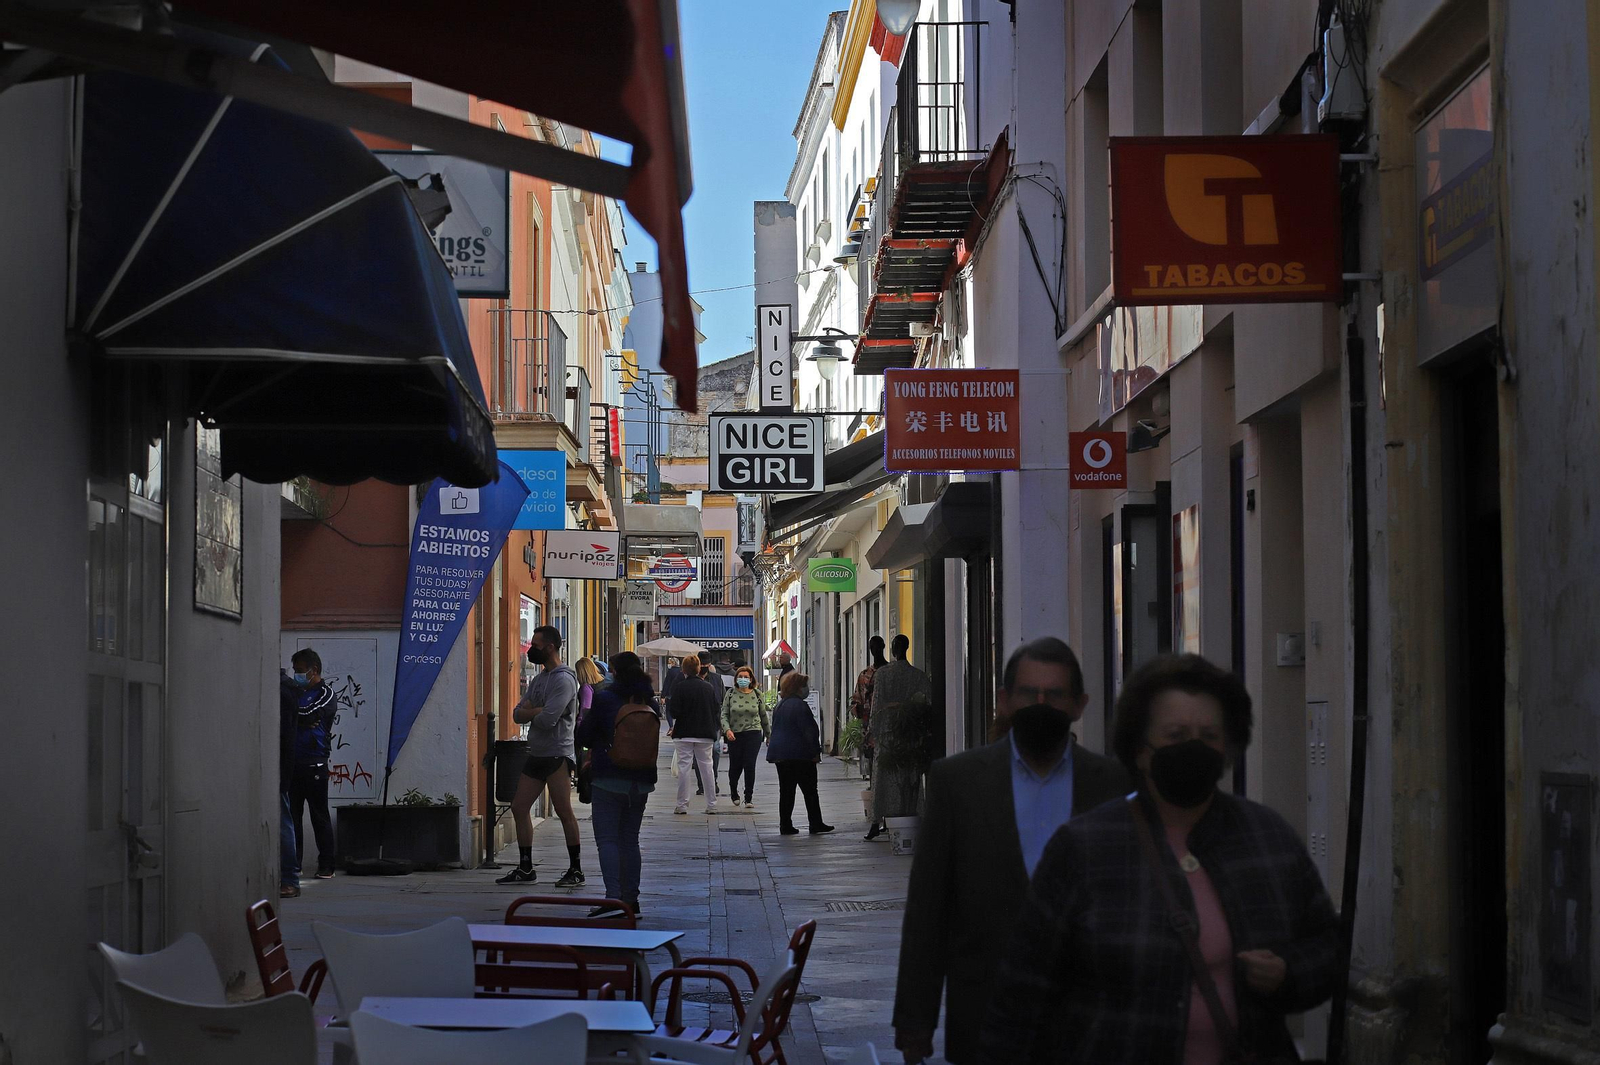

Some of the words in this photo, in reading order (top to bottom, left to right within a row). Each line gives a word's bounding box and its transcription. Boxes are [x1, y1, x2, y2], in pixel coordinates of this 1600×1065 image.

[1143, 261, 1307, 288] TABACOS
[768, 310, 784, 401] NICE
[893, 381, 926, 398] YONG
[929, 381, 959, 398] FENG
[962, 381, 1015, 398] TELECOM
[905, 410, 1008, 433] 荣丰电讯
[725, 423, 808, 449] NICE
[892, 448, 938, 460] ACCESORIOS
[939, 448, 982, 460] TELEFONOS
[983, 448, 1016, 460] MOVILES
[725, 457, 808, 484] GIRL
[1074, 471, 1122, 481] vodafone
[542, 488, 557, 499] de
[419, 524, 490, 543] ESTAMOS
[417, 540, 491, 558] ABIERTOS
[547, 550, 616, 563] nuripaz
[415, 564, 439, 575] PARA
[441, 567, 484, 579] RESOLVER
[814, 570, 850, 578] ALICOSUR
[415, 576, 433, 587] TUS
[412, 599, 439, 609] PARA
[441, 601, 461, 611] QUE
[411, 610, 456, 622] AHORRES
[410, 621, 424, 631] EN
[426, 622, 445, 632] LUZ
[409, 632, 417, 641] Y
[419, 633, 439, 643] GAS
[693, 641, 739, 649] HELADOS
